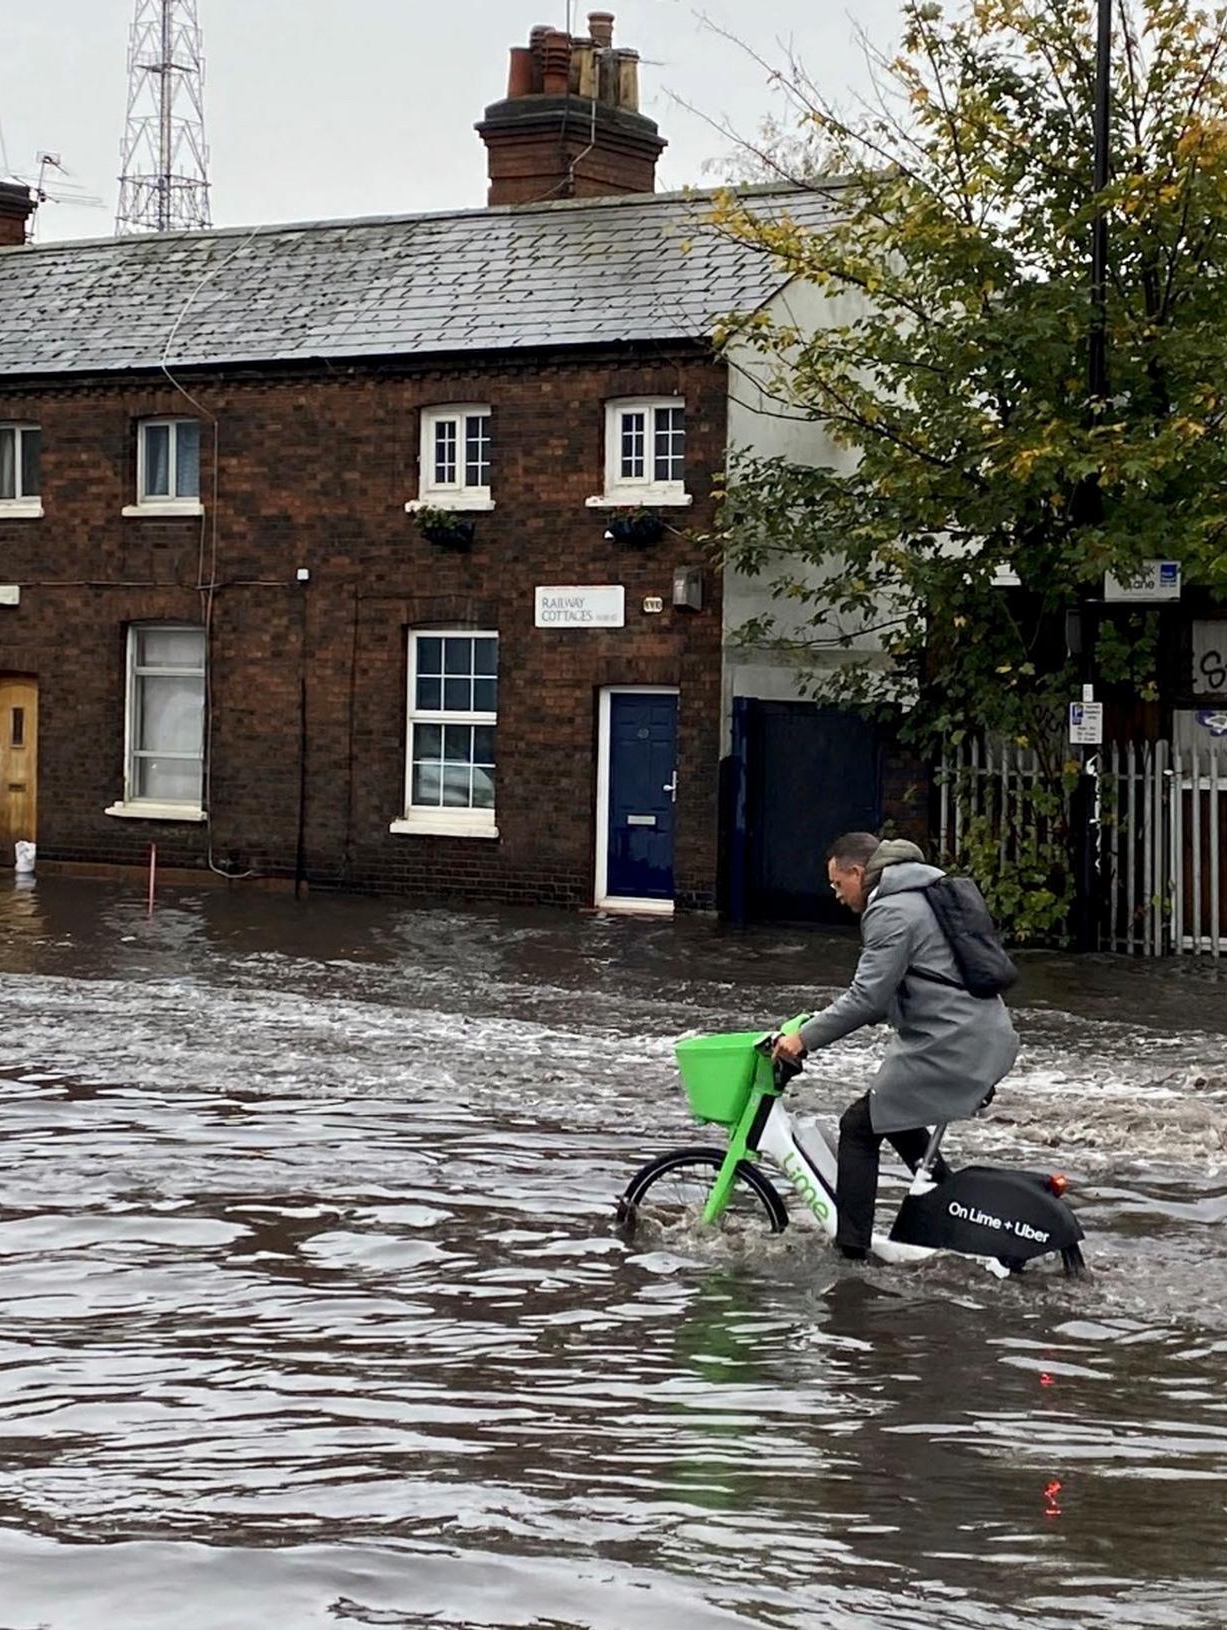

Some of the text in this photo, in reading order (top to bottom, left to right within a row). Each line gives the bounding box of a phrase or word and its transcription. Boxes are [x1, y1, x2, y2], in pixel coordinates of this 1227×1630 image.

[541, 597, 585, 608] RAILWAY
[541, 610, 592, 622] COTTAGES
[949, 1202, 1050, 1243] On Lime + Uber
